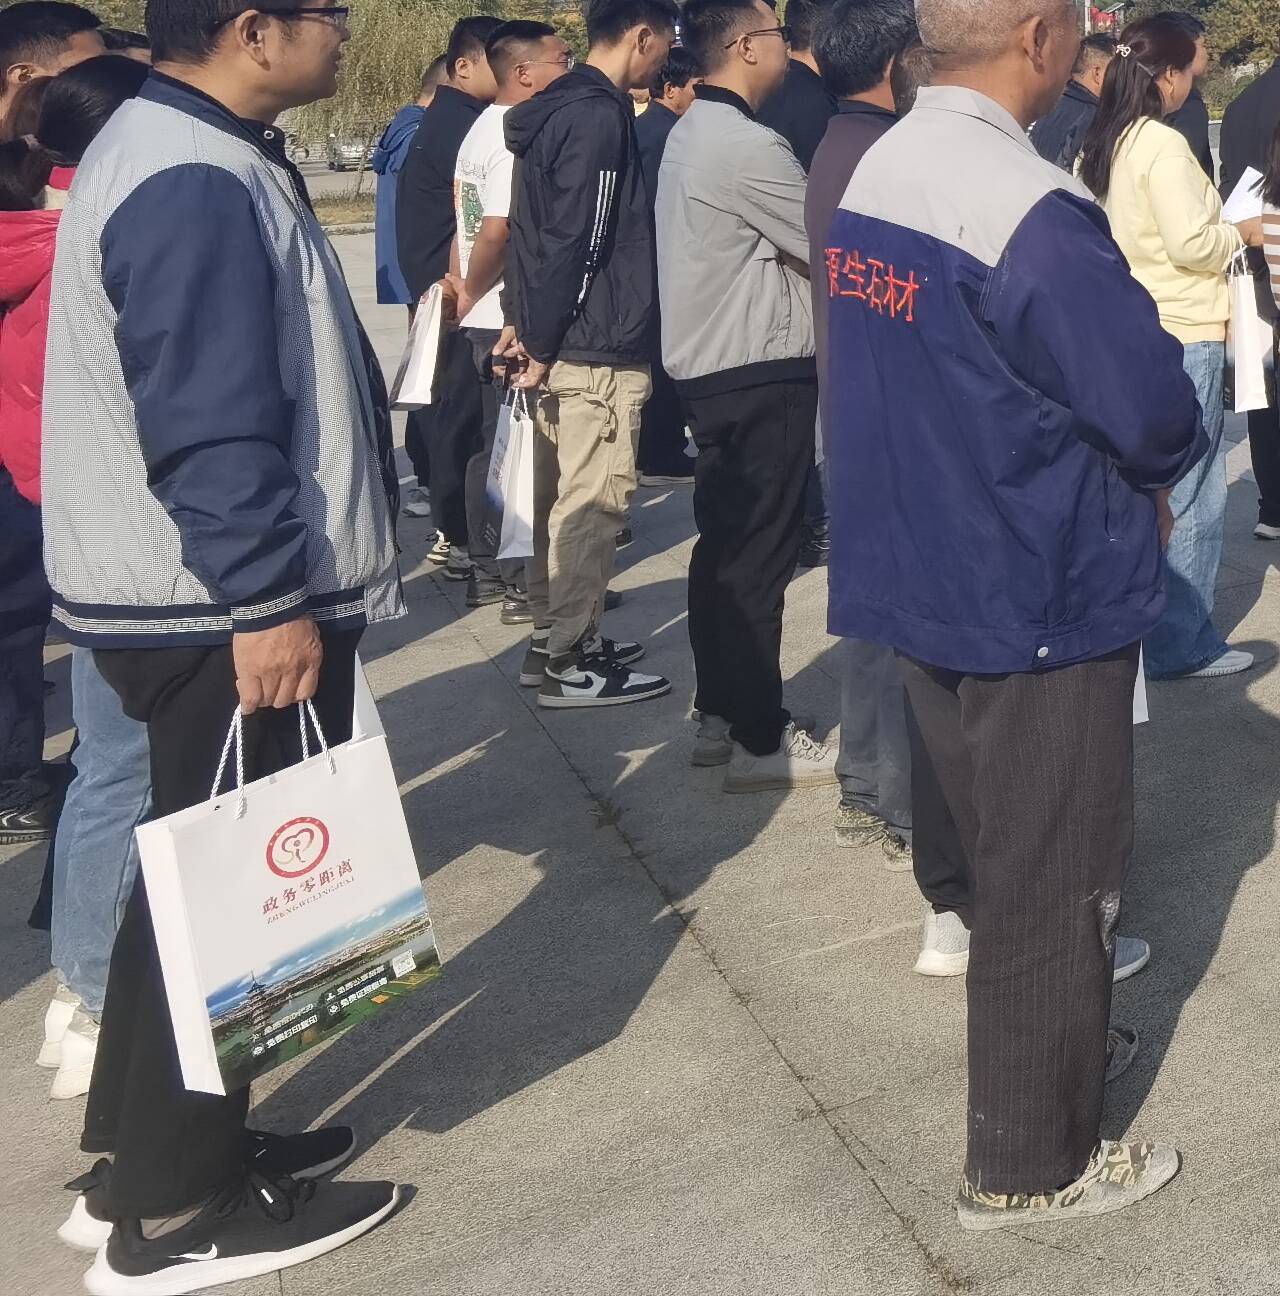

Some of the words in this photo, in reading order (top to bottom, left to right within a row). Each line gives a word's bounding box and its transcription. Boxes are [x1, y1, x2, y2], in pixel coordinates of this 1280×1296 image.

[262, 858, 353, 915] 政务零距离
